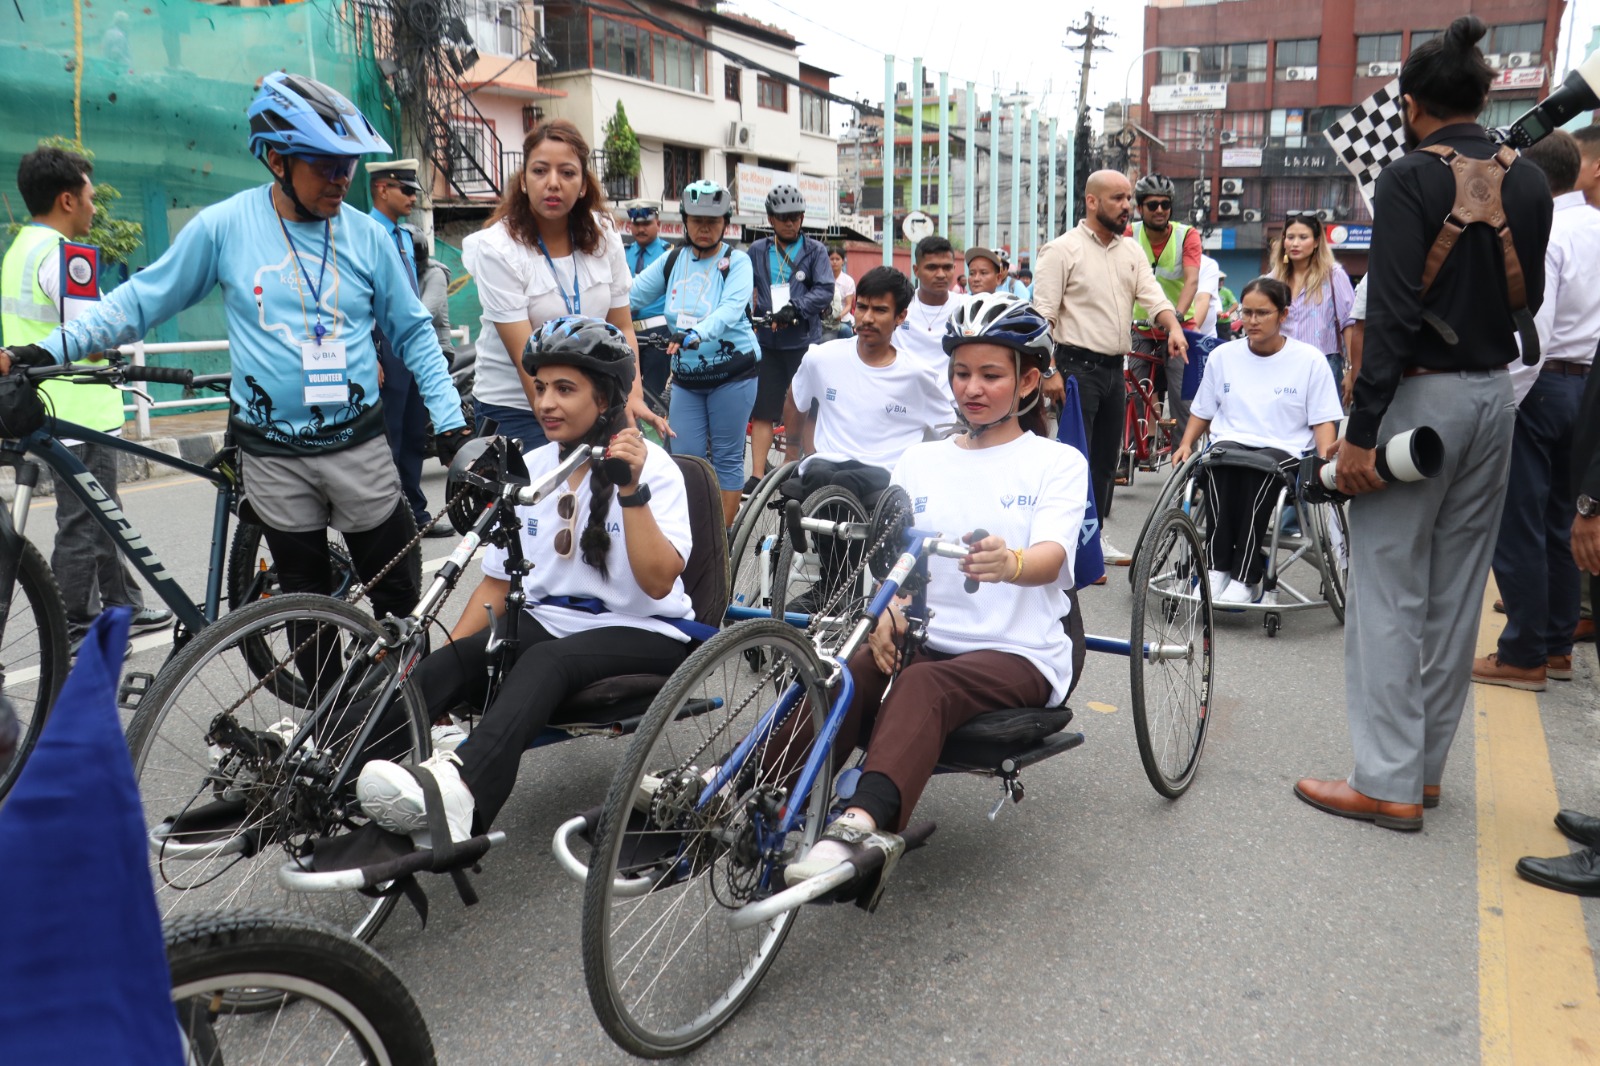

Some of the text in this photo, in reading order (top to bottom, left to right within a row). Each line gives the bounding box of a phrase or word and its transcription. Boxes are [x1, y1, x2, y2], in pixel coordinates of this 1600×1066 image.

[1284, 155, 1326, 168] LAXMI
[308, 373, 343, 383] VOLUNTEER
[1283, 387, 1298, 395] BIA
[893, 405, 907, 414] BIA
[73, 471, 173, 582] GIANT
